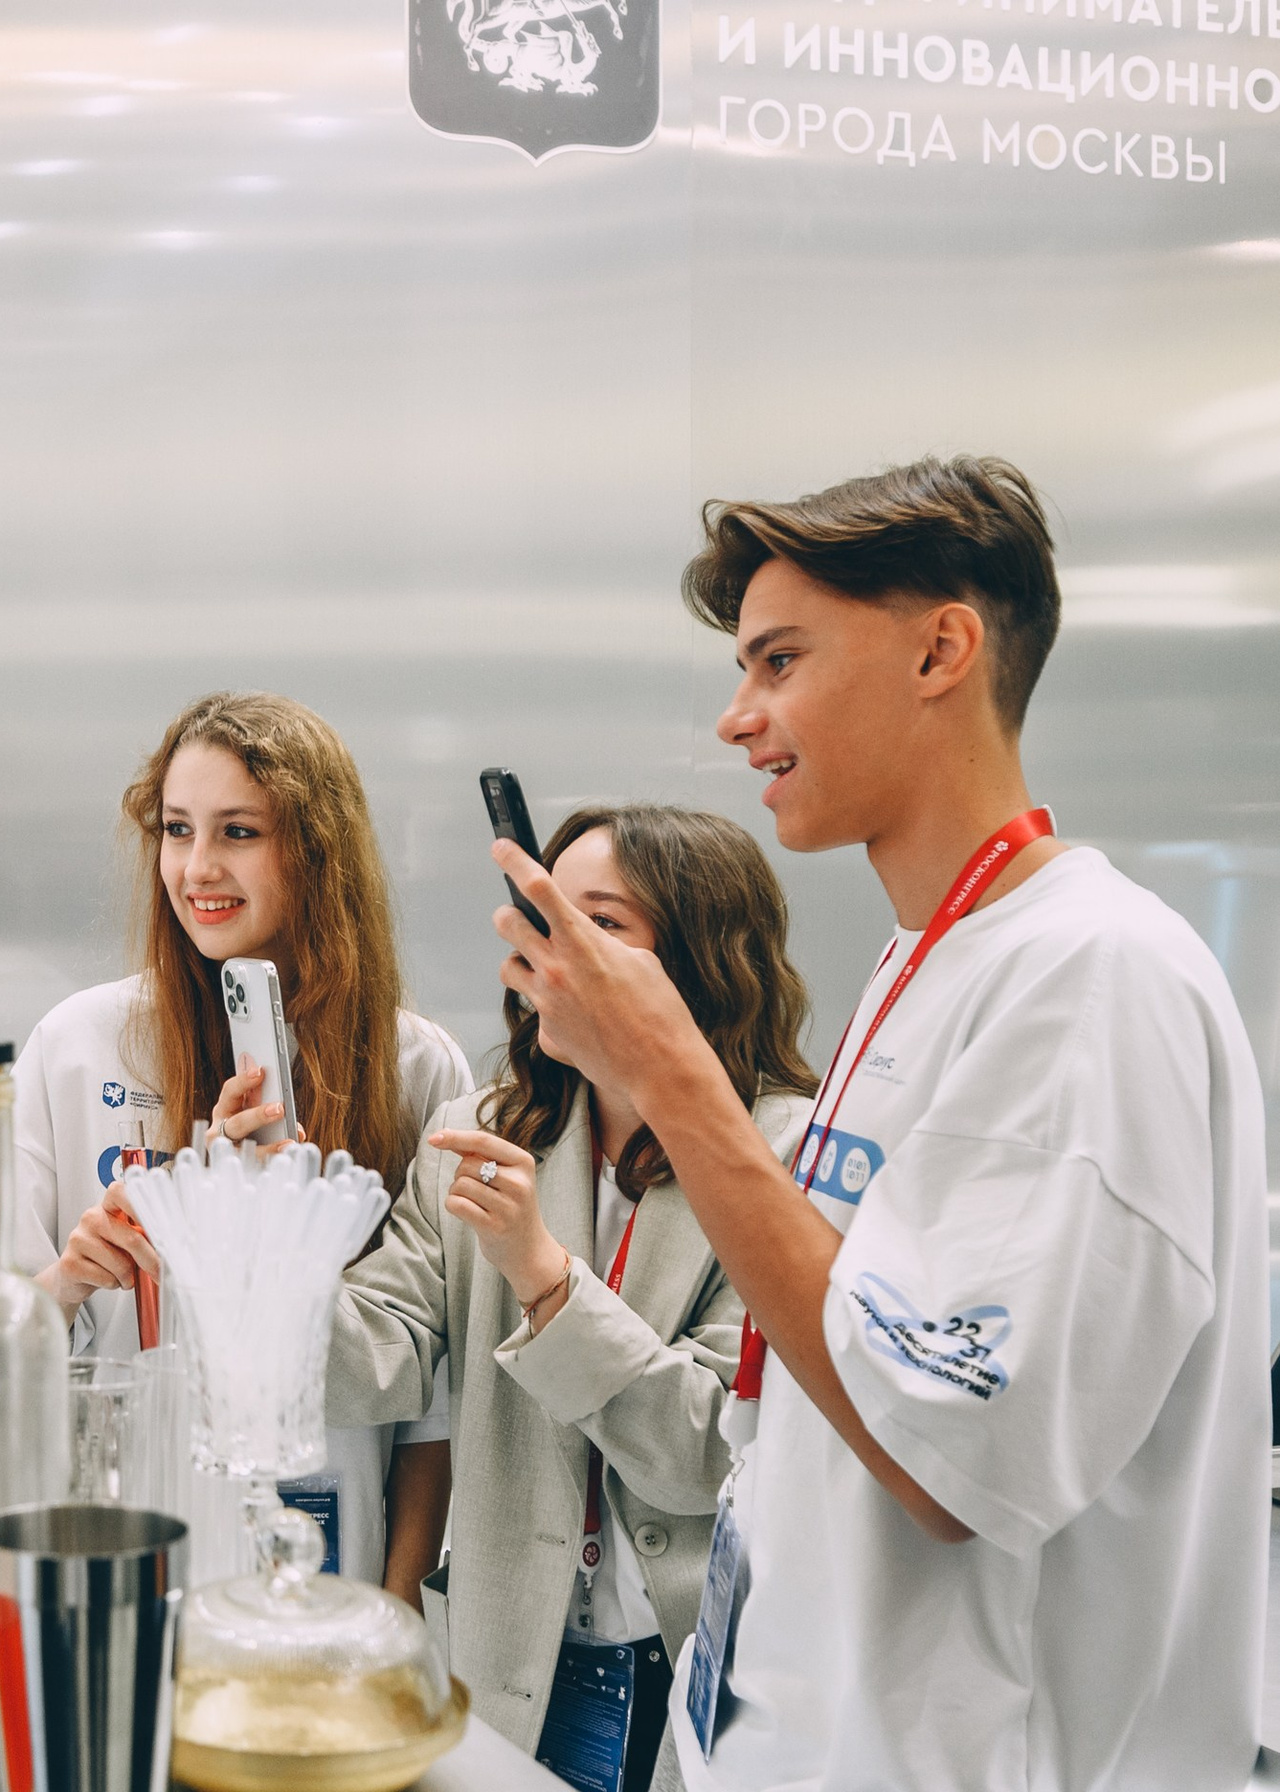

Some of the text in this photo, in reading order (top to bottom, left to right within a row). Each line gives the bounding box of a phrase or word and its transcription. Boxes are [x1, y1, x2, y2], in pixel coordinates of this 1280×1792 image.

[719, 15, 756, 66] И
[719, 95, 1228, 185] ГОРОДА МОСКВЫ
[949, 849, 1004, 916] РОСКОНГРЕСС
[849, 1289, 890, 1332] науки
[899, 1343, 993, 1402] технологий
[892, 1321, 1001, 1386] Десятилетие
[943, 1316, 982, 1340] 22
